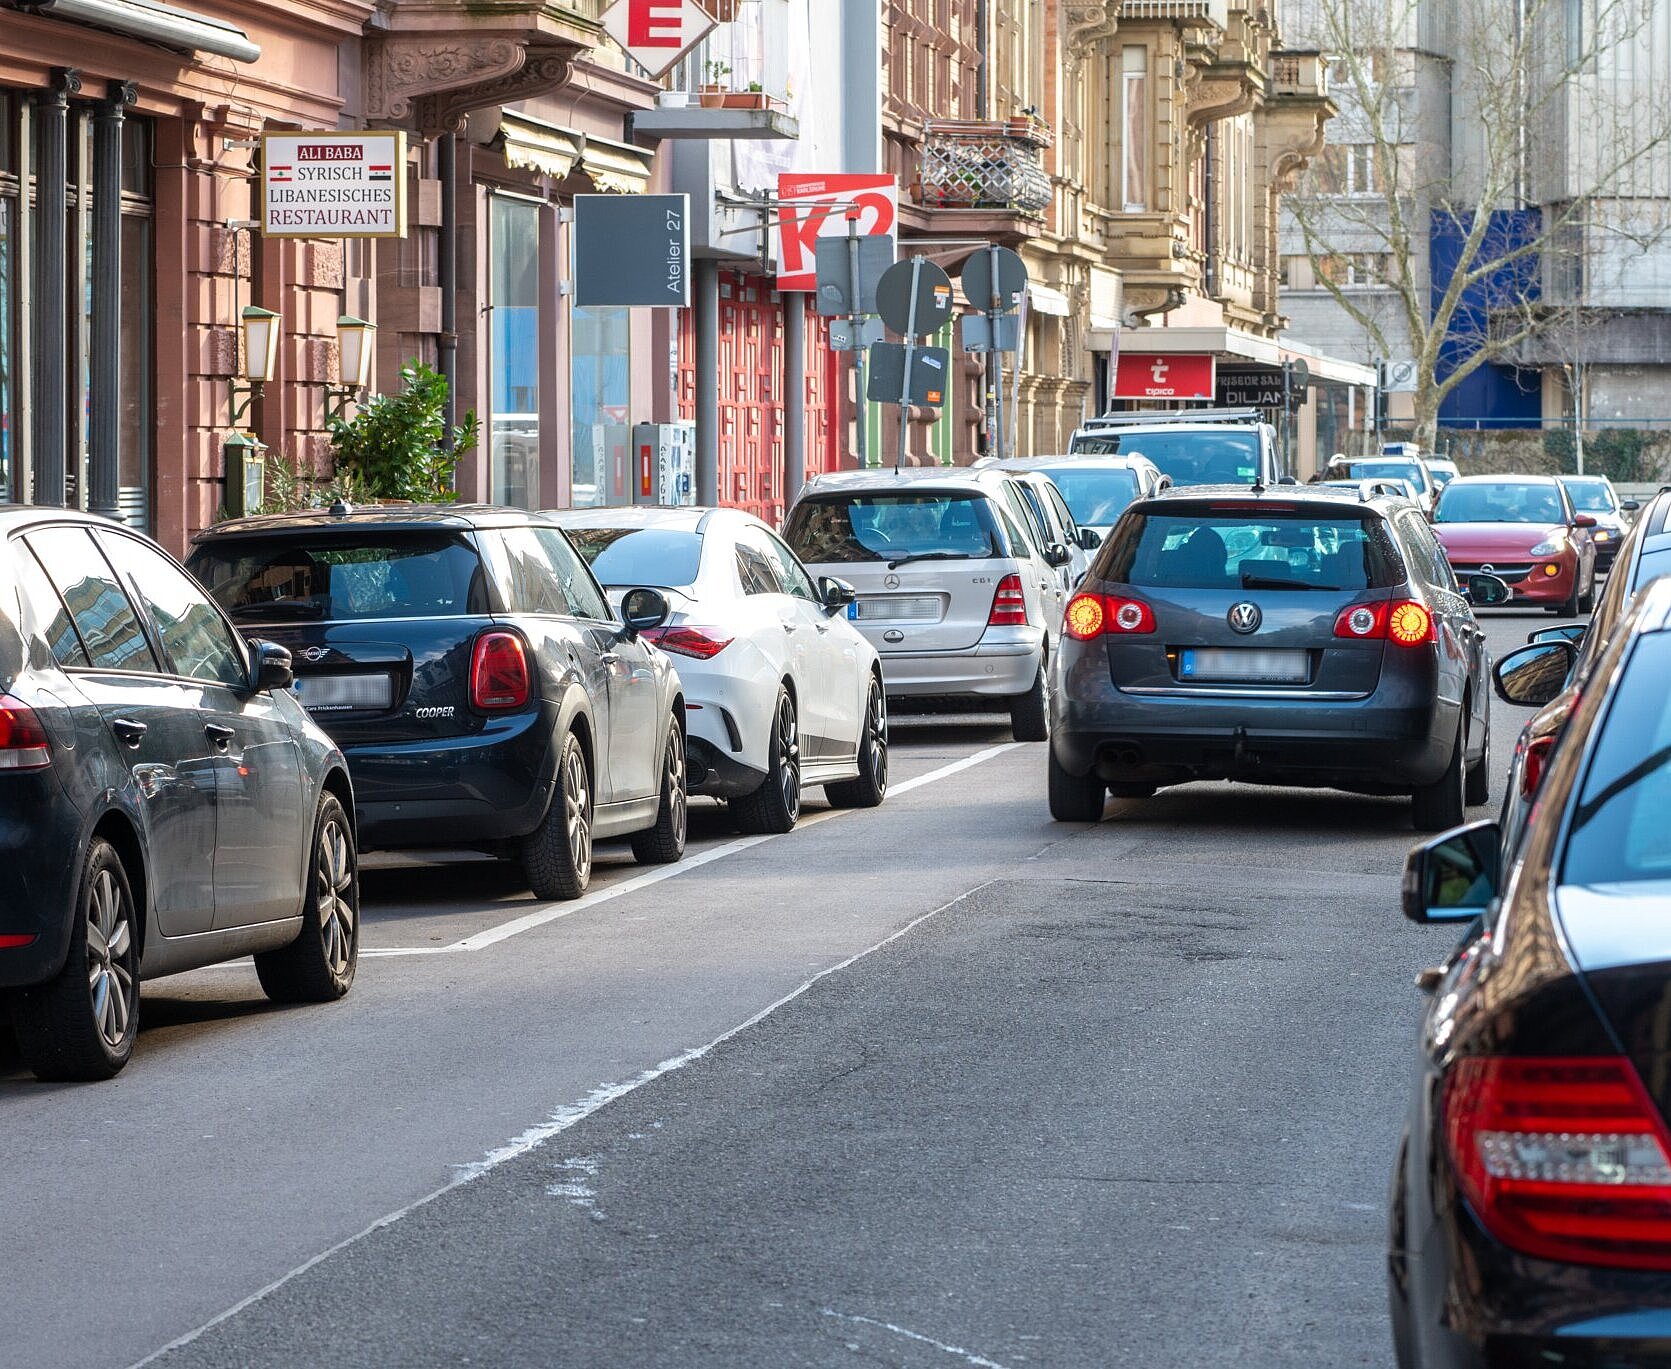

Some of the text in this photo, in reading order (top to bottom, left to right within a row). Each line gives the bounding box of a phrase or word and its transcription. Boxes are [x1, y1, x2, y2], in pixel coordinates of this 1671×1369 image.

[628, 0, 682, 48] E
[300, 147, 362, 160] ALI BABA
[298, 166, 363, 181] SYRISCH
[270, 188, 392, 203] LIBANESISCHES
[270, 209, 392, 225] RESTAURANT
[666, 209, 681, 293] Atelier 27
[1260, 375, 1282, 386] SAL
[1145, 387, 1175, 397] tipico
[415, 706, 455, 719] COOPER
